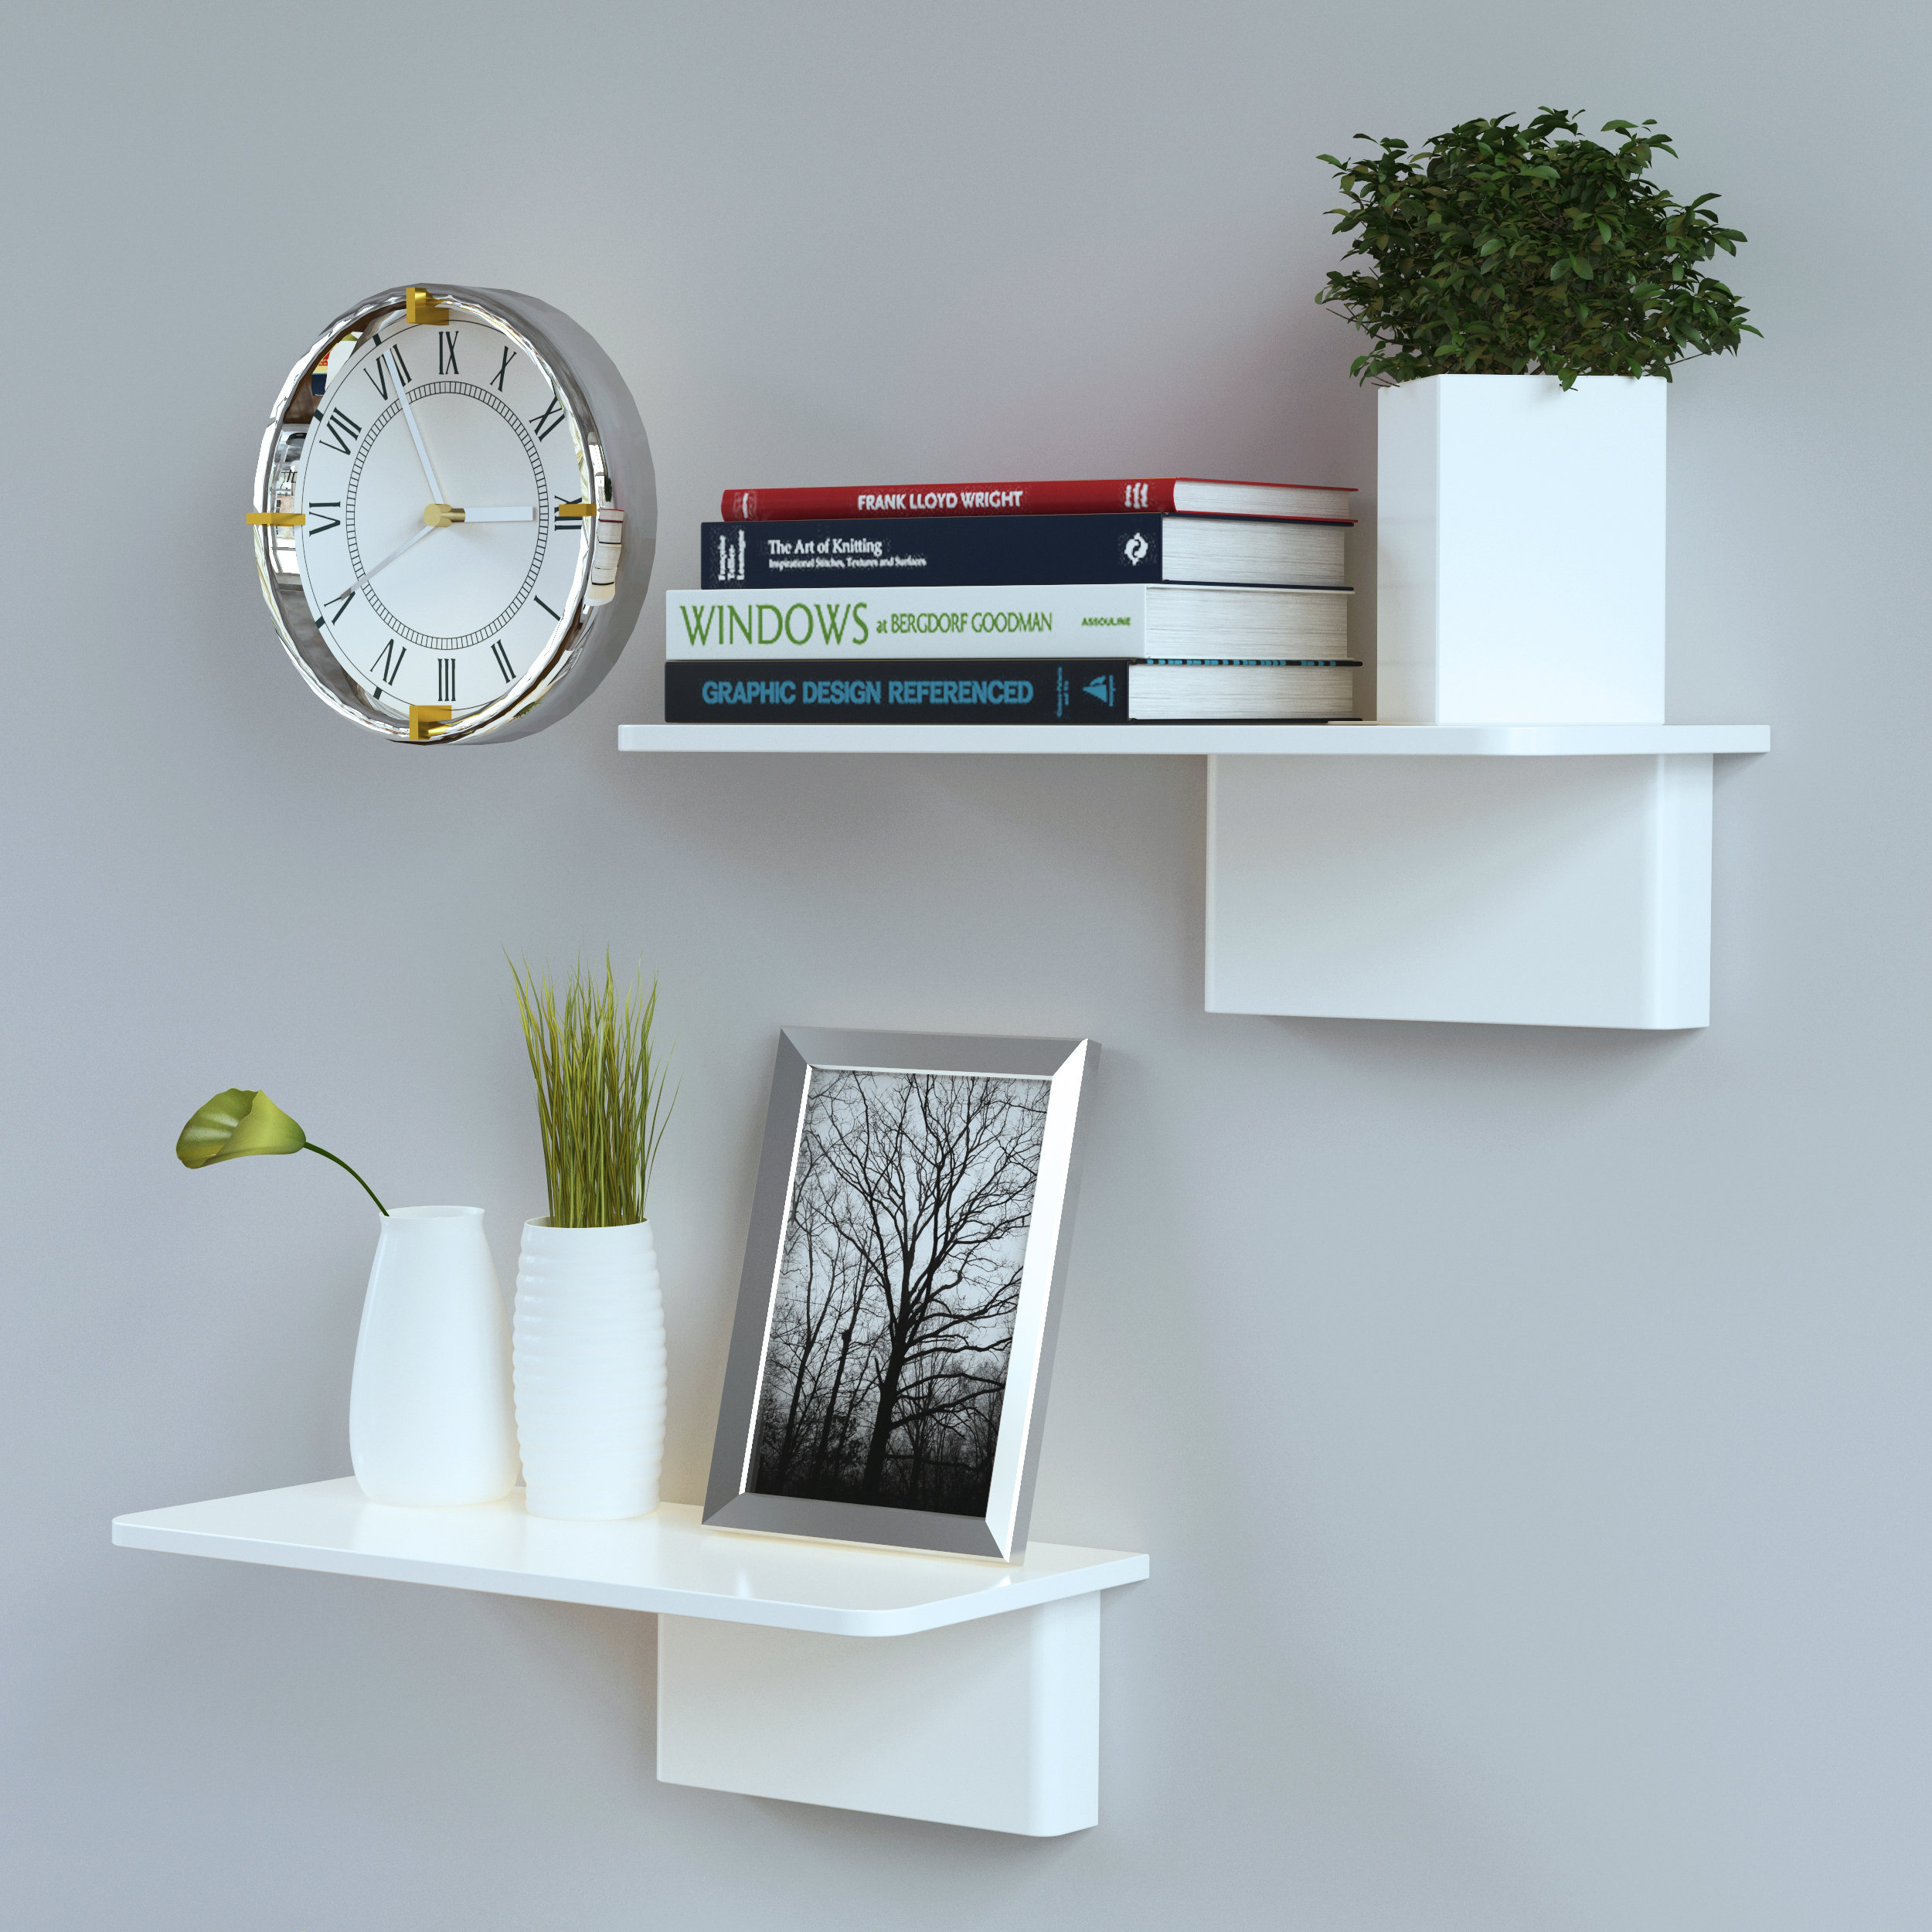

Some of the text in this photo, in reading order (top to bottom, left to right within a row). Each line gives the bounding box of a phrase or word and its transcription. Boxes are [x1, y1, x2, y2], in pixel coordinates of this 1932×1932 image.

[438, 330, 460, 376] IX
[489, 345, 517, 392] X
[318, 406, 362, 456] VII
[529, 396, 566, 443] XI
[308, 501, 341, 537] VI
[857, 490, 1024, 511] FRANK LLOYD WRIGHT
[767, 538, 883, 557] The Art of Knitting
[679, 602, 1052, 646] WINDOWS at BERGDORF GOODMAN
[437, 658, 456, 702] III
[701, 680, 797, 705] GRAPHIC
[802, 680, 883, 705] DESIGN
[888, 680, 1034, 705] REFERENCED
